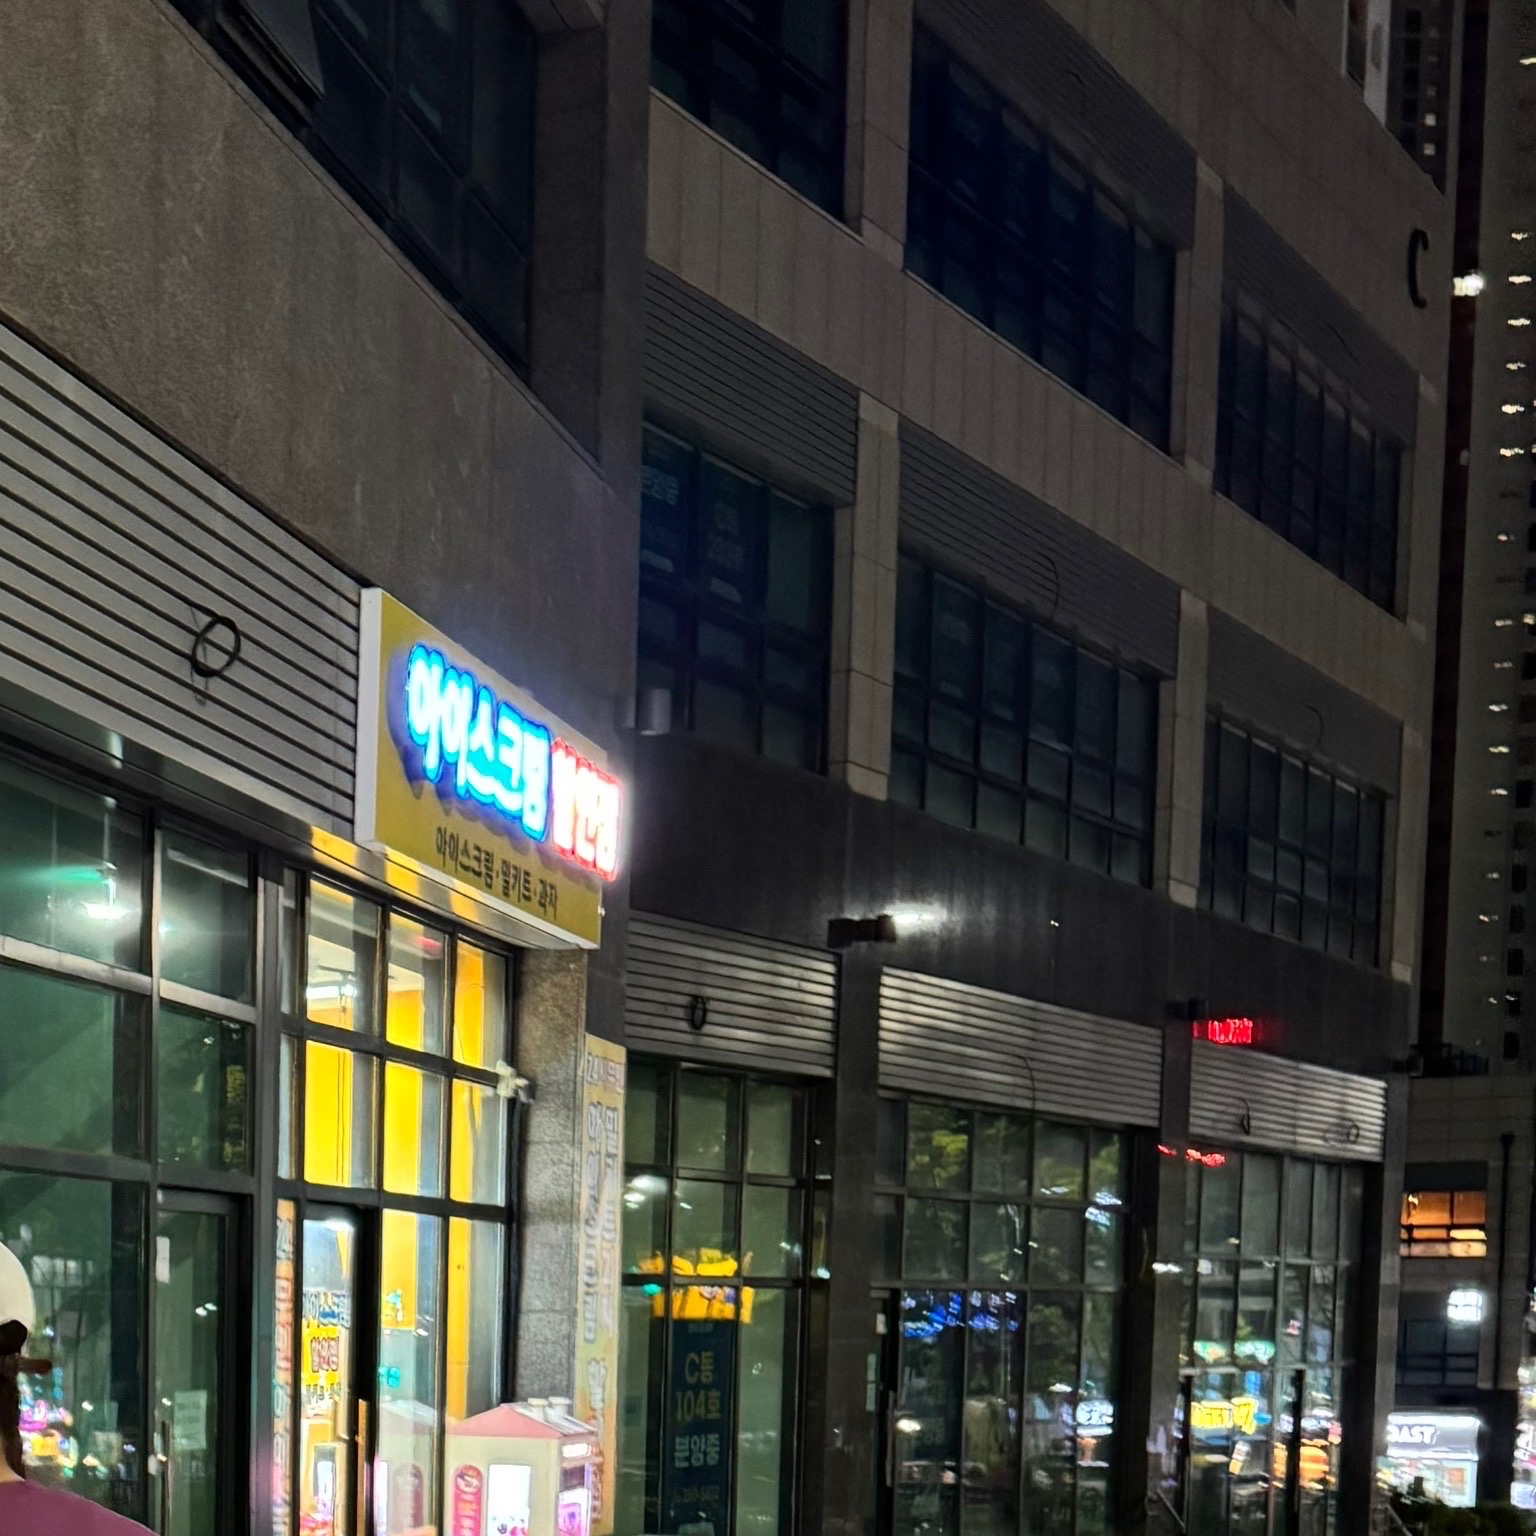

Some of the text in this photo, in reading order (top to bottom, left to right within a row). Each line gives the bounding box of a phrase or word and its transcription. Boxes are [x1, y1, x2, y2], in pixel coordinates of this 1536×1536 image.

[1407, 227, 1429, 309] C
[406, 643, 551, 844] 아이스크림
[684, 1350, 715, 1385] C동
[676, 1390, 722, 1426] 104호
[673, 1434, 721, 1469] 분양중
